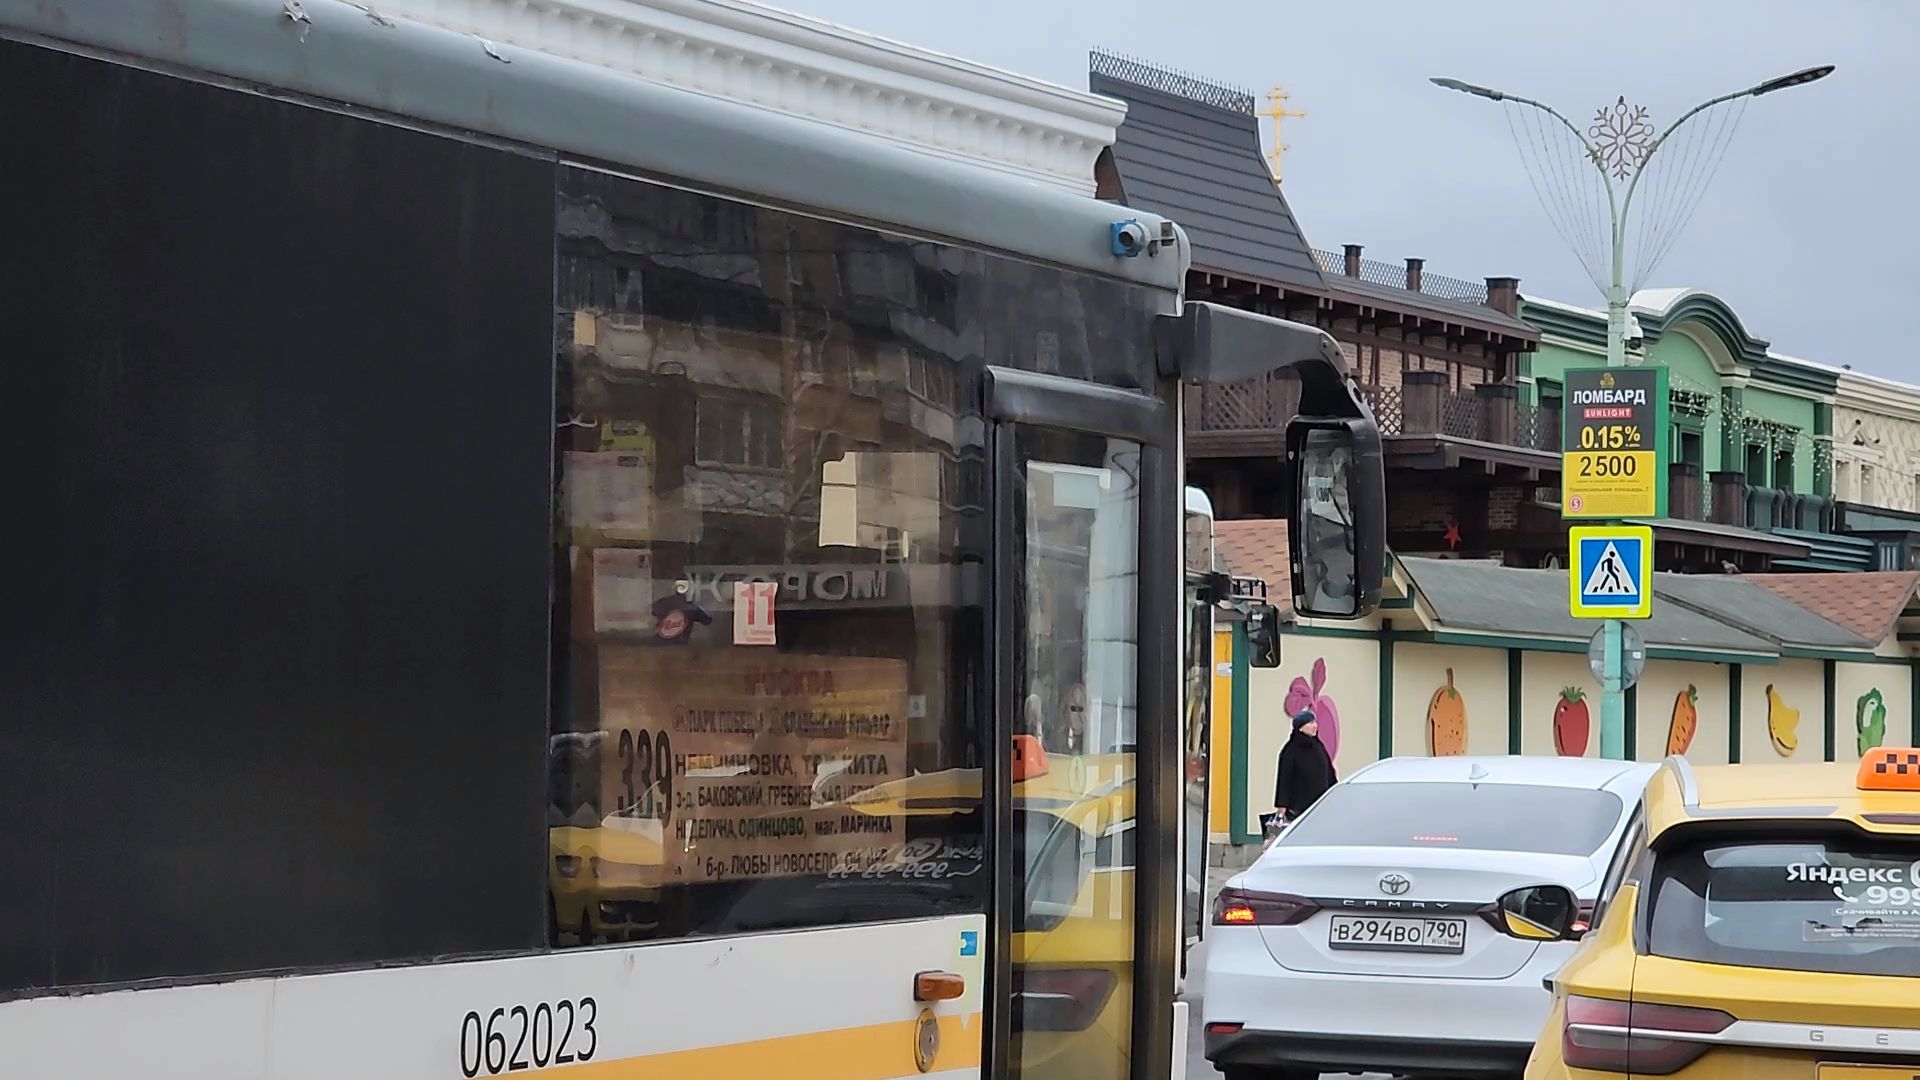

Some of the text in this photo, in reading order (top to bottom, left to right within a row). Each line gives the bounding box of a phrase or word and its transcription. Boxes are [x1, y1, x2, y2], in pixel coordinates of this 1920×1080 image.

[1573, 389, 1646, 405] ЛОМБАРД
[1585, 408, 1631, 417] SUNLIGHT
[1581, 425, 1641, 449] 0.15%
[740, 584, 776, 625] 11
[618, 728, 672, 829] 339
[841, 815, 892, 834] МАРИНКА
[730, 853, 771, 875] ЛЮБЫ
[1786, 862, 1902, 884] Яндекс
[1835, 908, 1899, 916] Скачивайте
[1426, 922, 1457, 938] 790
[461, 997, 597, 1078] 062023
